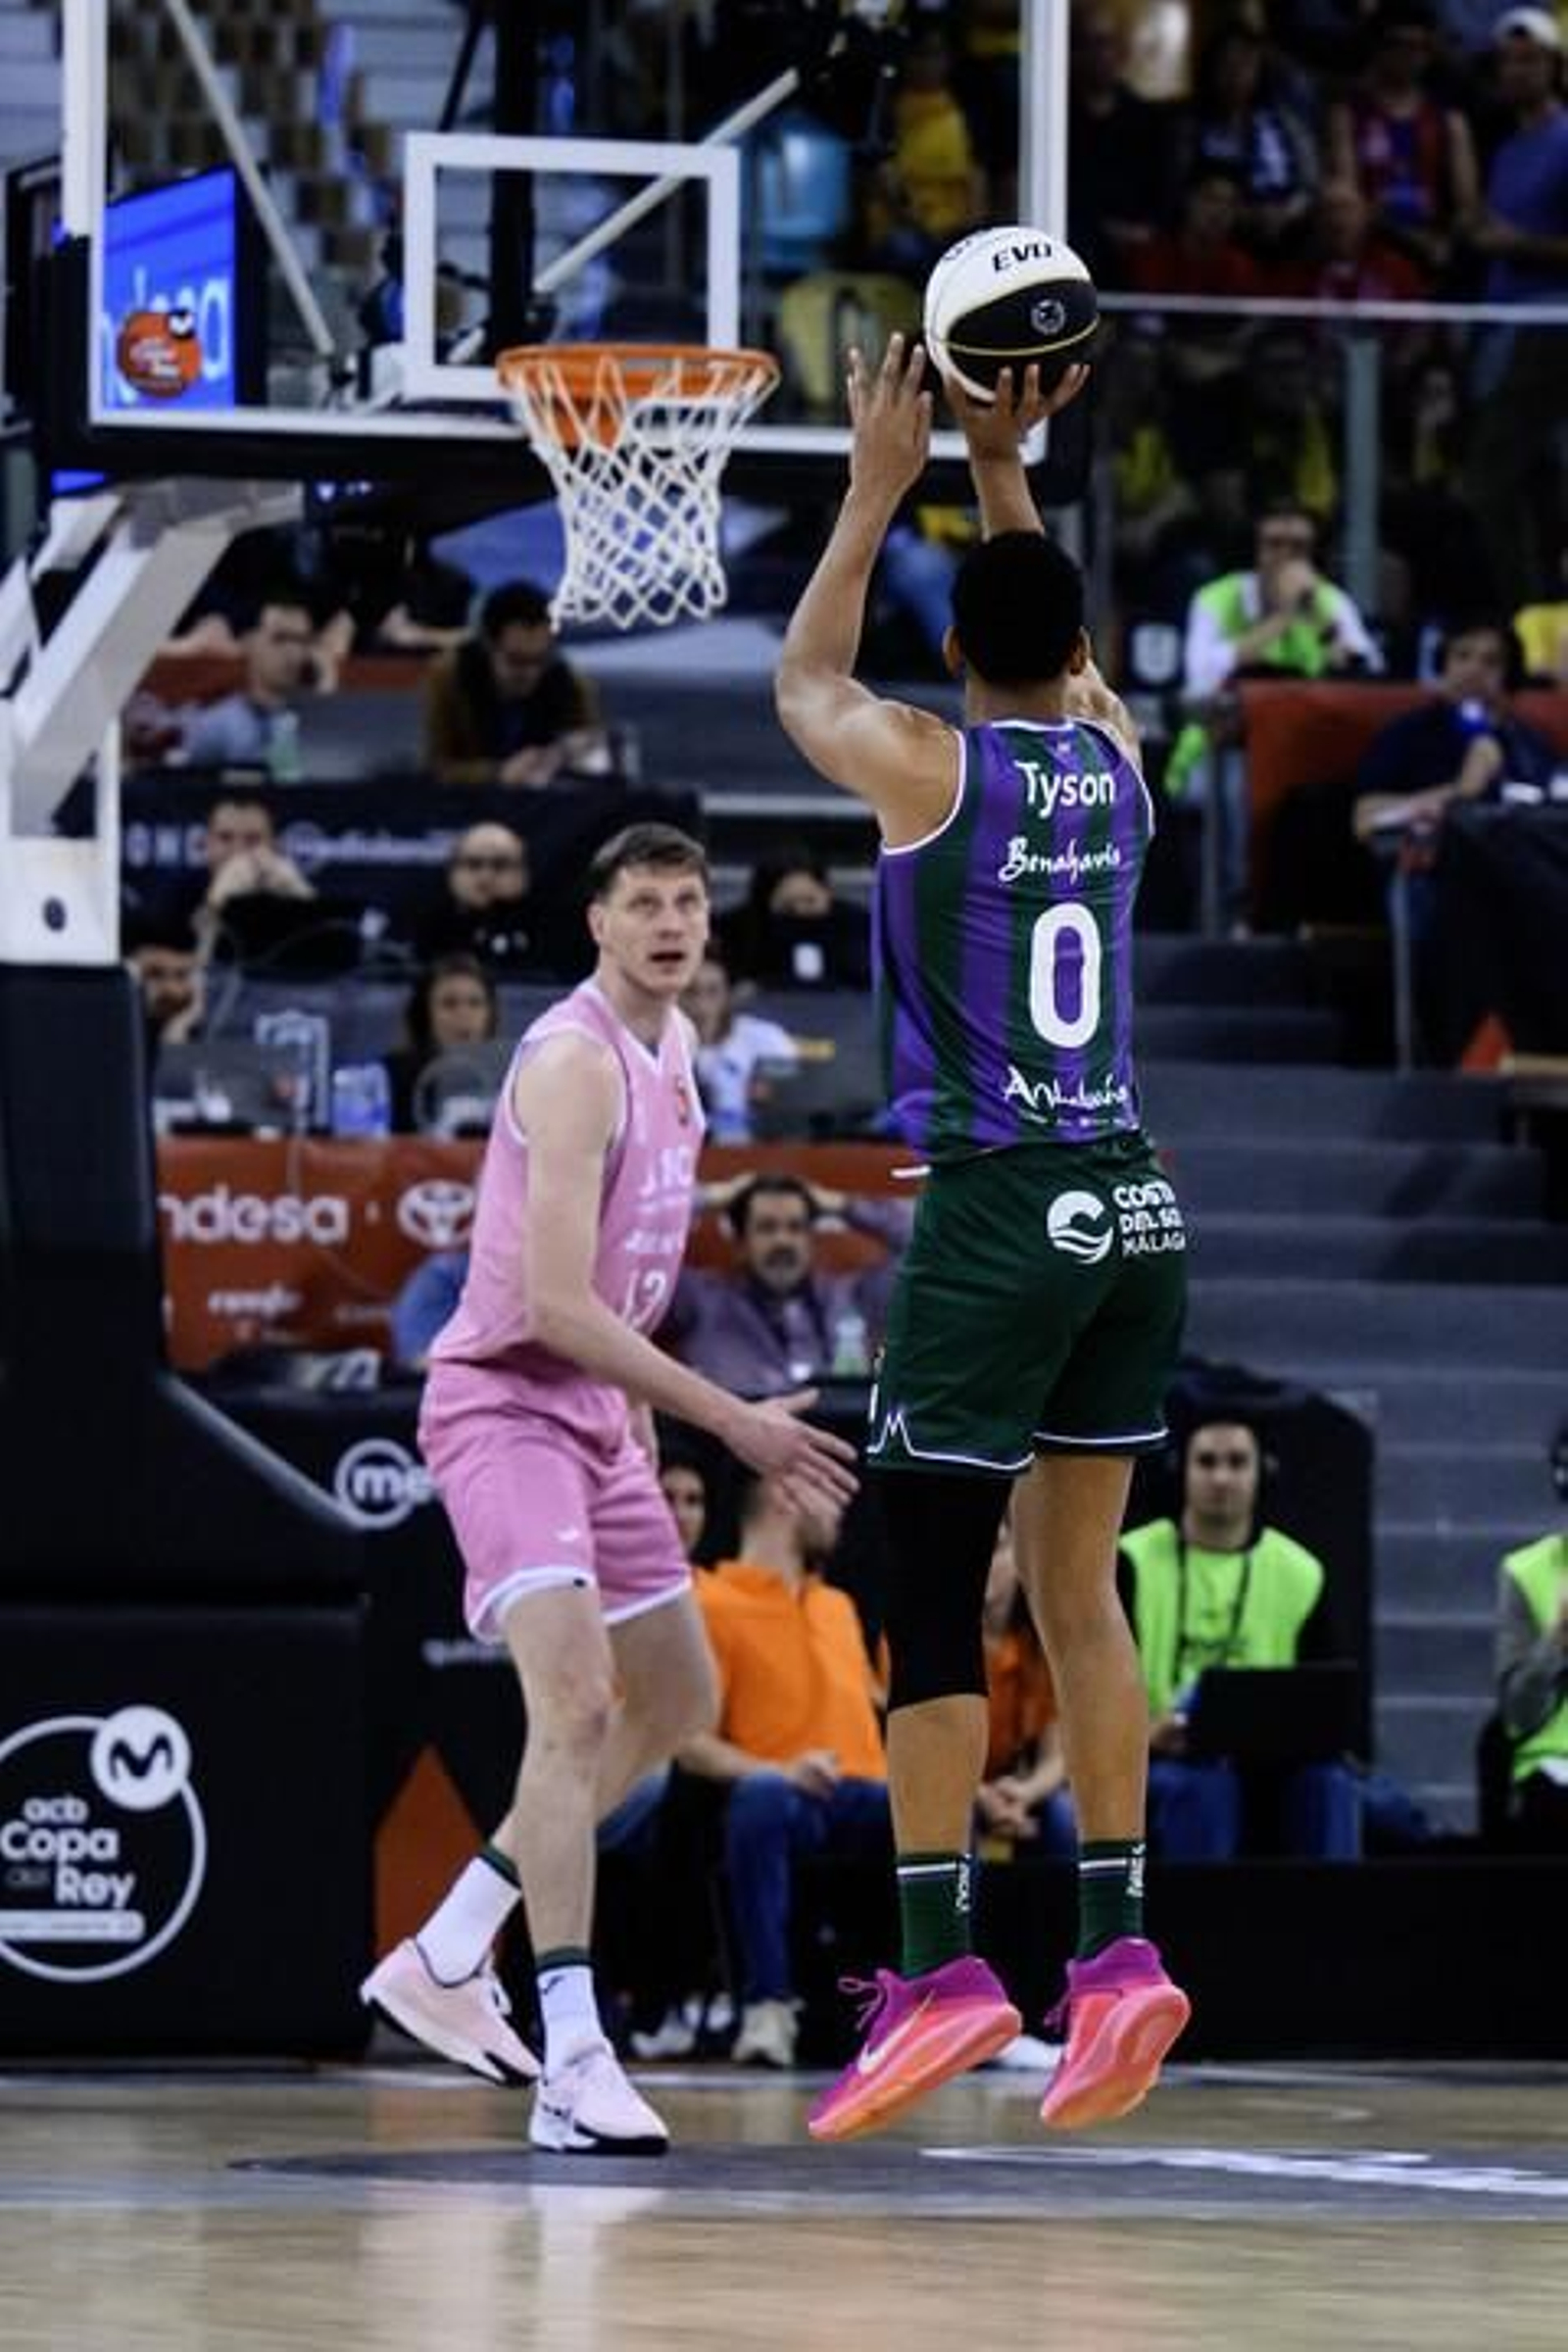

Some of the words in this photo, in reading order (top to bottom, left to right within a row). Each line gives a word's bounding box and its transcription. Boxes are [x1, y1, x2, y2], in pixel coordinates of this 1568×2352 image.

[1013, 760, 1115, 818] Tyson
[1029, 903, 1102, 1049] 0
[23, 1795, 89, 1824] acb
[0, 1821, 120, 1872] Copa
[55, 1866, 135, 1909] Rey
